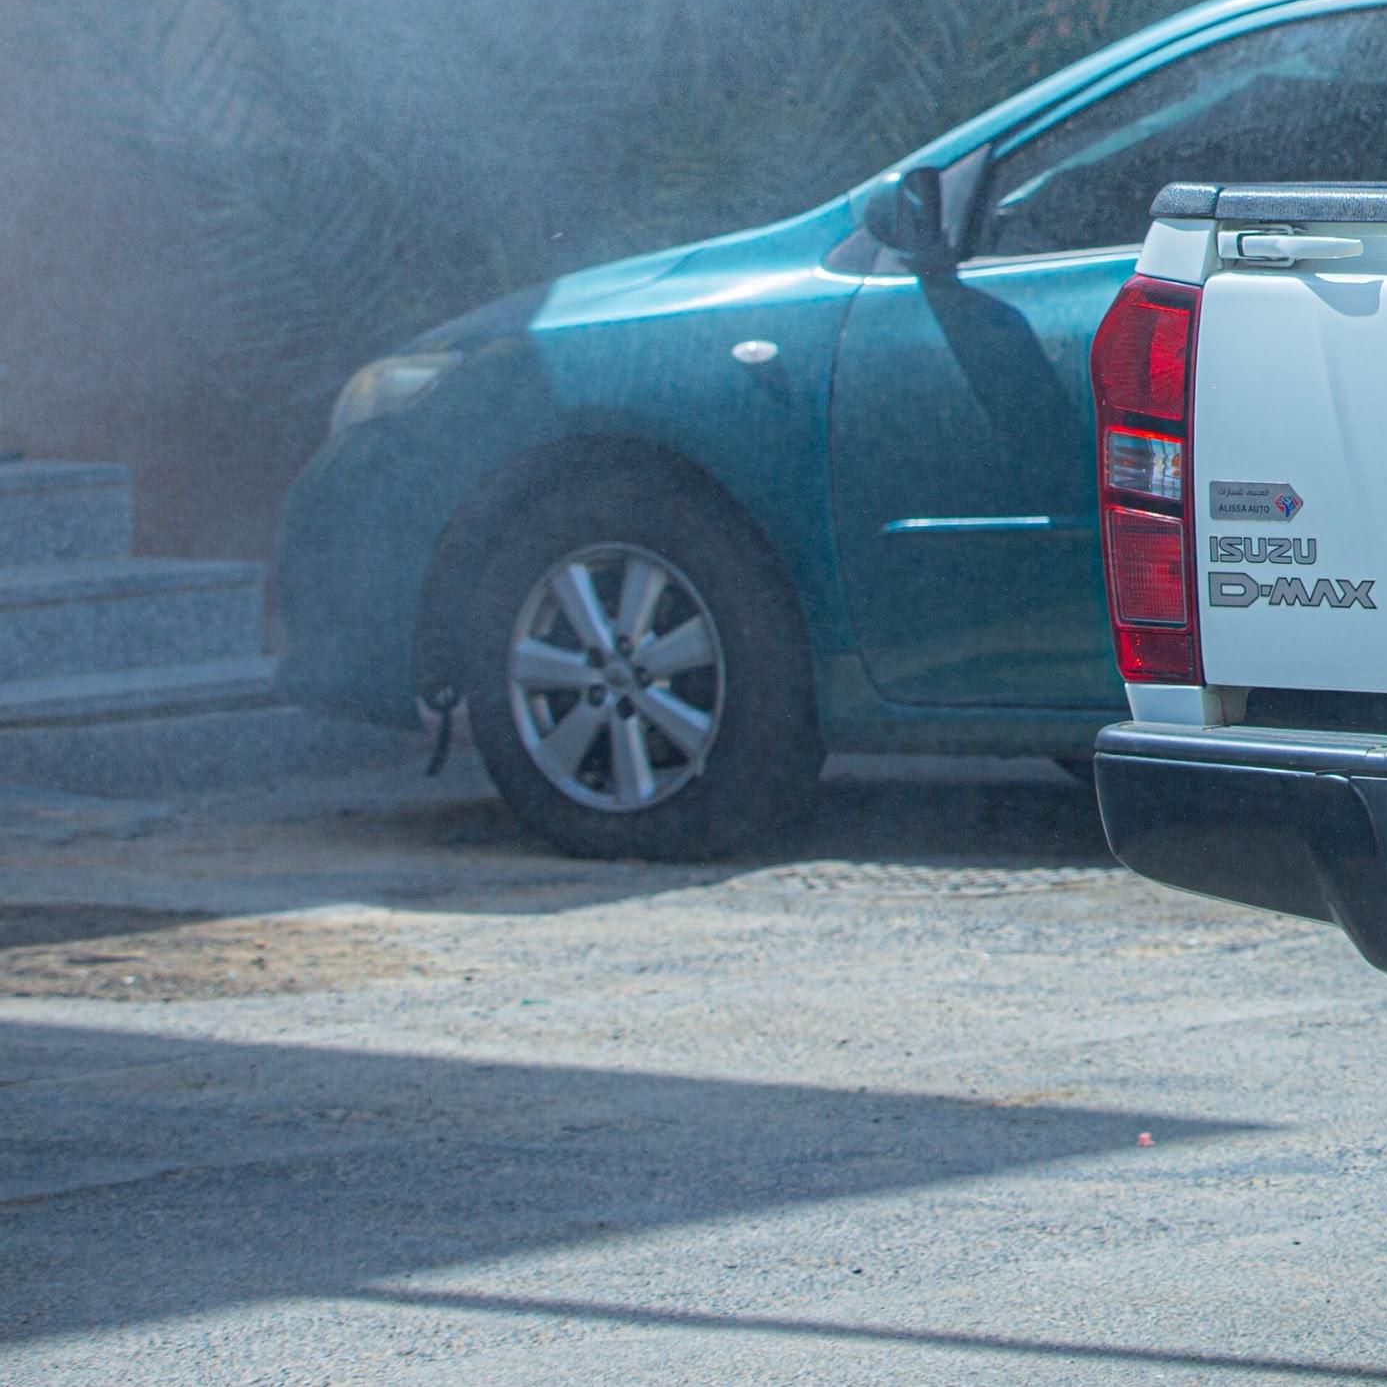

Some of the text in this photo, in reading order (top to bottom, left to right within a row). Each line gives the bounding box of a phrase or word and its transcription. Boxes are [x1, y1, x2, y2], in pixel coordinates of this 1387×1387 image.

[1218, 504, 1271, 514] ALISSA AUTO
[1209, 536, 1317, 565] ISUZU
[1208, 571, 1377, 610] D-MAX
